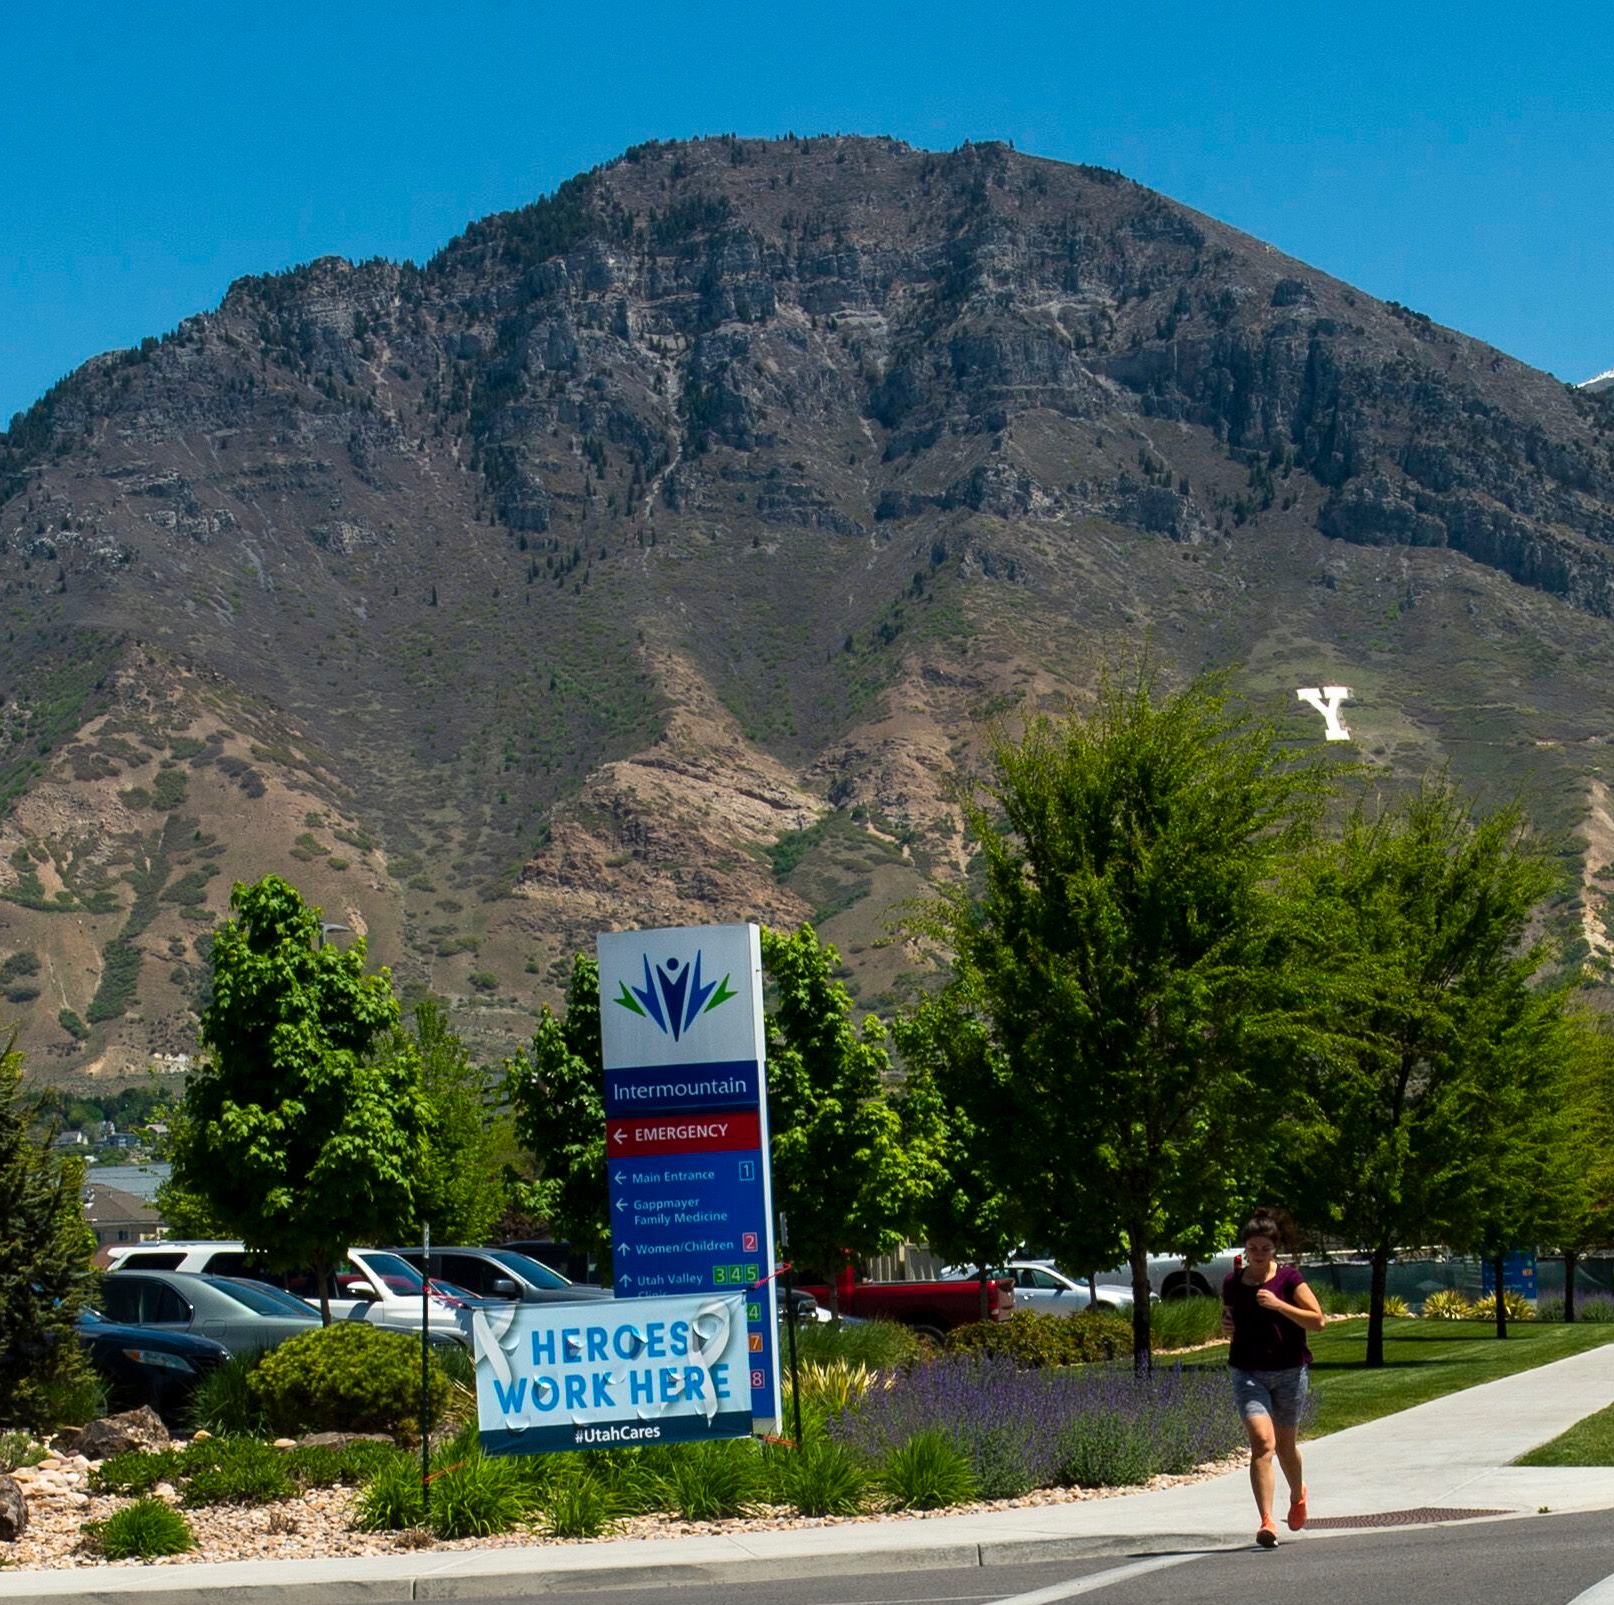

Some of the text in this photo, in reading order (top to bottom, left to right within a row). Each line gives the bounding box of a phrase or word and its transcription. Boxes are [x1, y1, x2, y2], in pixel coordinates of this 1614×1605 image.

[1296, 686, 1351, 741] Y
[614, 1076, 747, 1100] Intermountain
[635, 1123, 728, 1142] EMERGENCY
[633, 1172, 661, 1184] Main
[664, 1170, 715, 1182] Entrance
[633, 1198, 701, 1211] Gappmayer
[634, 1211, 728, 1226] Family Medicine
[636, 1235, 755, 1255] Women/Children 2
[637, 1266, 756, 1286] Utah Valley 3 4 5
[749, 1305, 759, 1319] 4
[531, 1320, 689, 1365] HEROES
[751, 1335, 760, 1350] 7
[752, 1372, 762, 1386] 8
[493, 1363, 731, 1415] WORK HERE
[575, 1425, 661, 1444] #UtahCares
